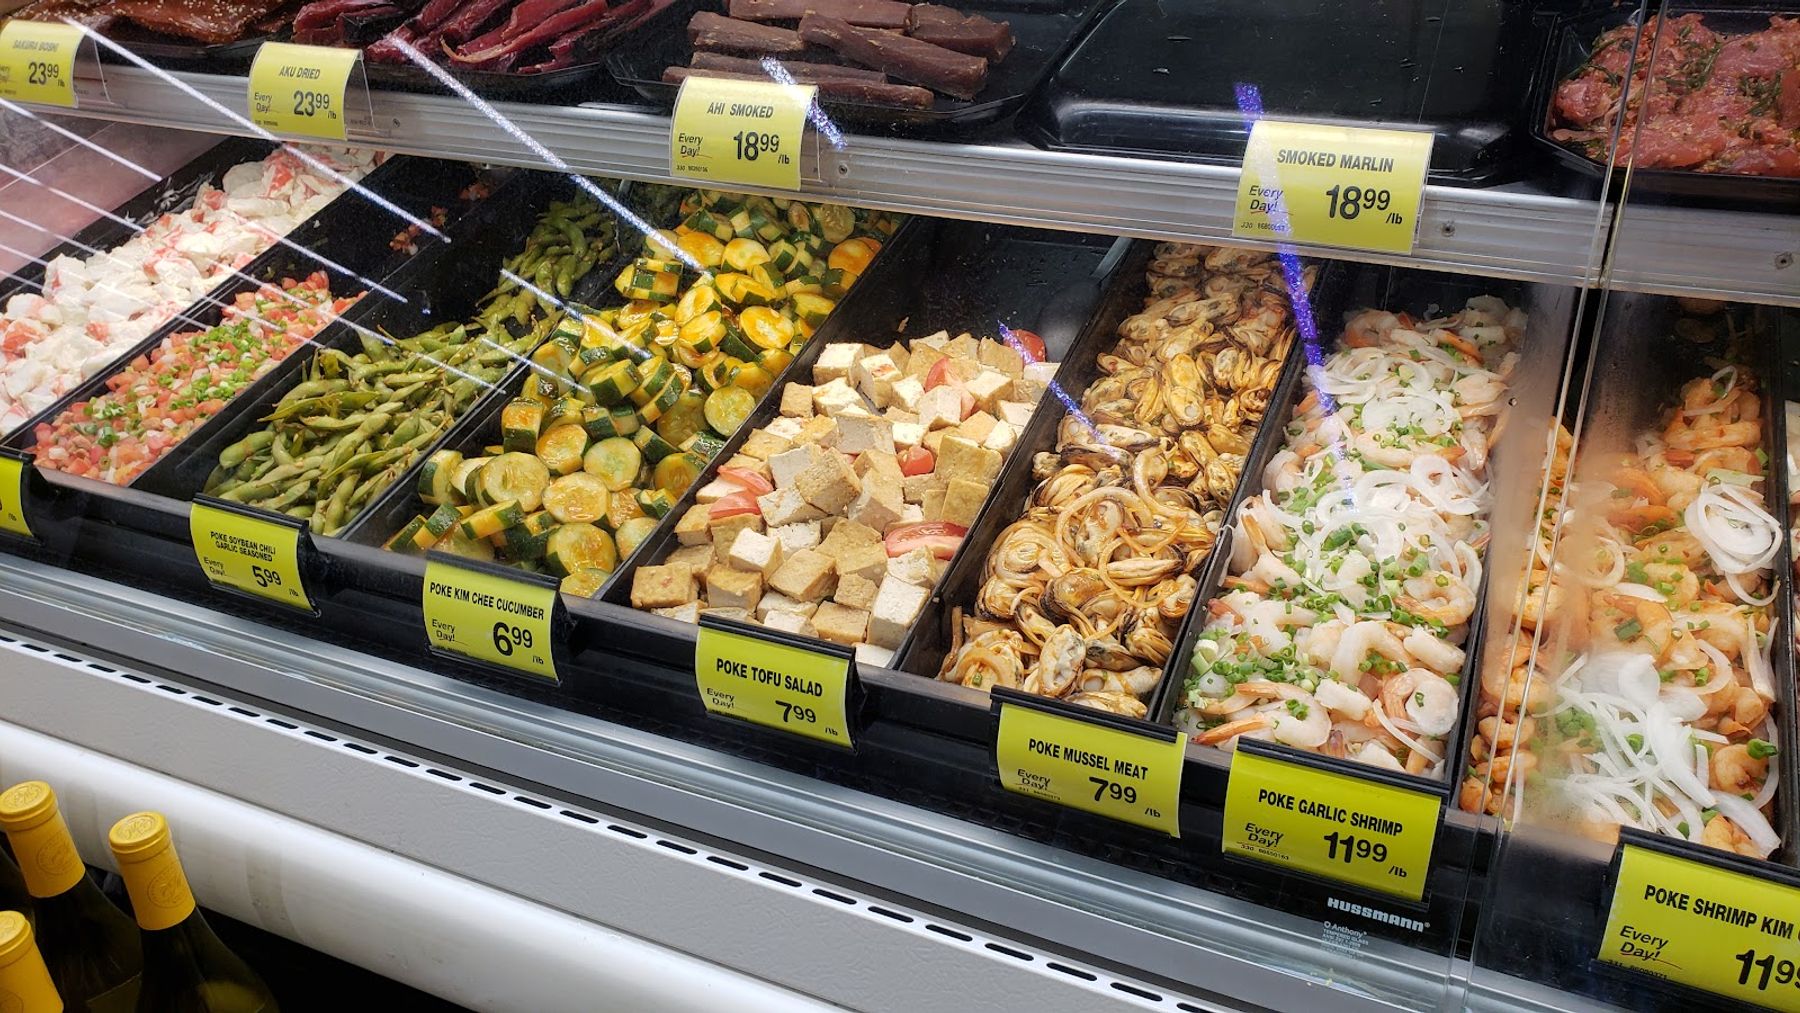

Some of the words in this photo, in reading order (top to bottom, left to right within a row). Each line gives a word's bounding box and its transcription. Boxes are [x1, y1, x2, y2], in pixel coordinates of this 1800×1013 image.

[28, 62, 60, 86] 2399
[279, 65, 297, 78] AKU
[297, 67, 321, 80] DRIED
[254, 92, 273, 103] Every
[293, 90, 330, 117] 2399
[327, 111, 337, 120] /lb
[707, 102, 726, 115] AHI
[729, 103, 774, 119] SMOKED
[678, 132, 704, 146] Every
[733, 131, 780, 161] 1899
[777, 154, 791, 165] /lb
[680, 145, 702, 159] Day!
[1276, 149, 1337, 168] SMOKED
[1339, 154, 1395, 173] MARLIN
[1248, 184, 1284, 200] Every
[1249, 199, 1280, 215] Day!
[1325, 184, 1392, 221] 1899
[1385, 213, 1403, 225] /lb
[210, 531, 228, 541] POKE
[228, 535, 259, 550] SOYBEAN
[259, 543, 276, 555] CHILI
[215, 540, 239, 553] GARLIC
[239, 547, 273, 562] SEASONED
[203, 556, 225, 569] Every
[251, 564, 282, 588] 599
[430, 582, 453, 598] POKE
[453, 587, 470, 602] KIM
[471, 592, 495, 608] CHEE
[496, 598, 545, 621] CUCUMBER
[431, 618, 456, 634] Every
[436, 630, 456, 642] Day!
[493, 621, 533, 657] 699
[532, 655, 545, 665] /lb
[716, 657, 748, 679] POKE
[751, 666, 782, 687] TOFU
[784, 675, 823, 698] SALAD
[706, 687, 736, 702] Every
[712, 697, 735, 710] Day!
[775, 700, 817, 724] 799
[1028, 738, 1061, 759] POKE
[1063, 747, 1111, 772] MUSSEL
[1114, 759, 1149, 781] MEAT
[1017, 768, 1051, 787] Every
[1021, 777, 1049, 791] Day!
[1088, 776, 1138, 804] 799
[1144, 807, 1161, 819] /lb
[1258, 788, 1295, 811] POKE
[1298, 799, 1348, 823] GARLIC
[1350, 811, 1404, 837] SHRIMP
[1244, 822, 1284, 843] Every
[1247, 833, 1280, 849] Day!
[1323, 831, 1388, 864] 1199
[1388, 865, 1408, 878] /lb
[1643, 884, 1690, 911] POKE
[1692, 897, 1758, 929] SHRIMP
[1760, 916, 1795, 940] KIM
[1619, 925, 1669, 951] Every
[1620, 941, 1661, 962] Day!
